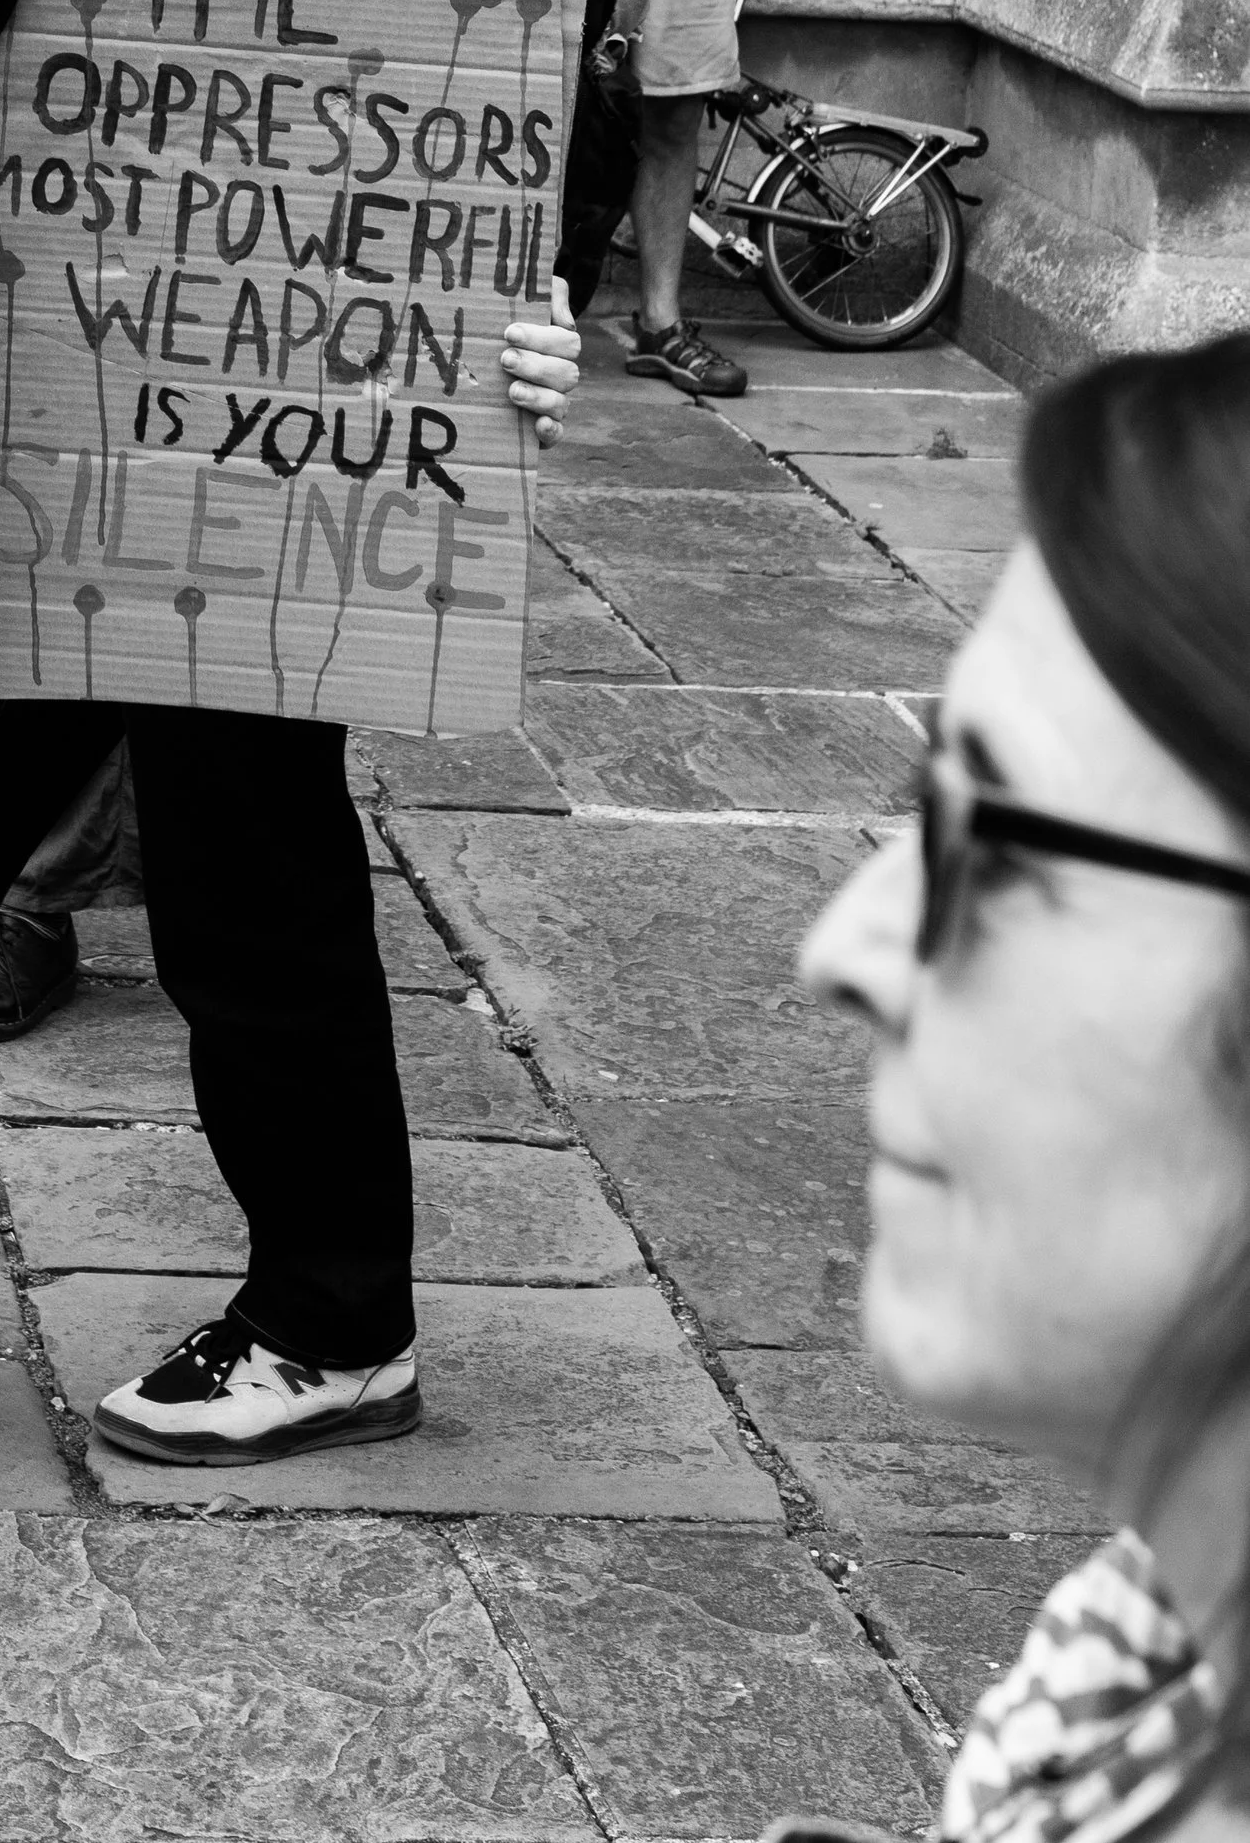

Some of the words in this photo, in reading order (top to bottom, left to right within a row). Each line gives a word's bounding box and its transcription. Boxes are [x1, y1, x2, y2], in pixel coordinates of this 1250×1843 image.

[33, 52, 554, 187] OPPRESSORS
[175, 169, 553, 303] POWERFUL
[65, 261, 465, 397] WEAPON
[135, 382, 191, 445] IS
[213, 393, 466, 507] YOUR
